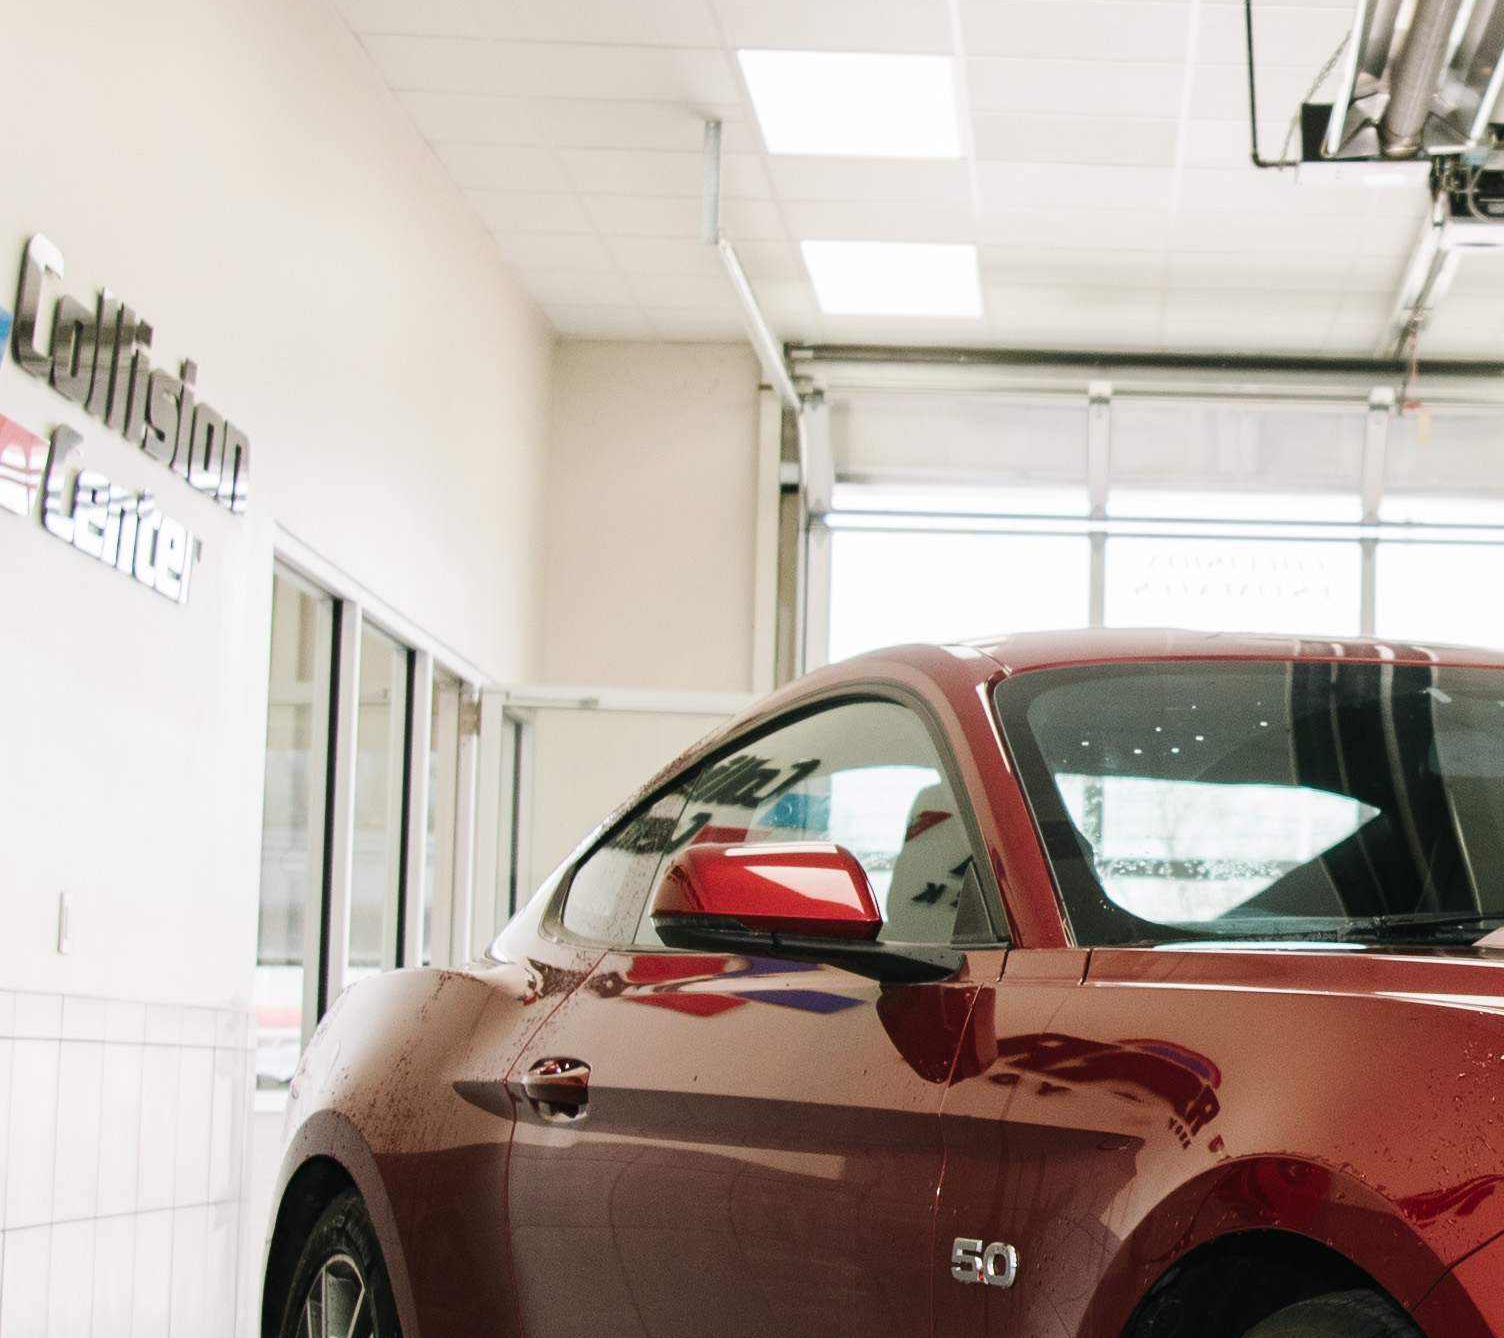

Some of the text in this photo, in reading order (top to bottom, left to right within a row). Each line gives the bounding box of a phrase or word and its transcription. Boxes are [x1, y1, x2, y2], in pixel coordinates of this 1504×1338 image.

[12, 232, 250, 514] Collision
[42, 423, 202, 605] Center
[951, 1237, 1018, 1289] 5.0
